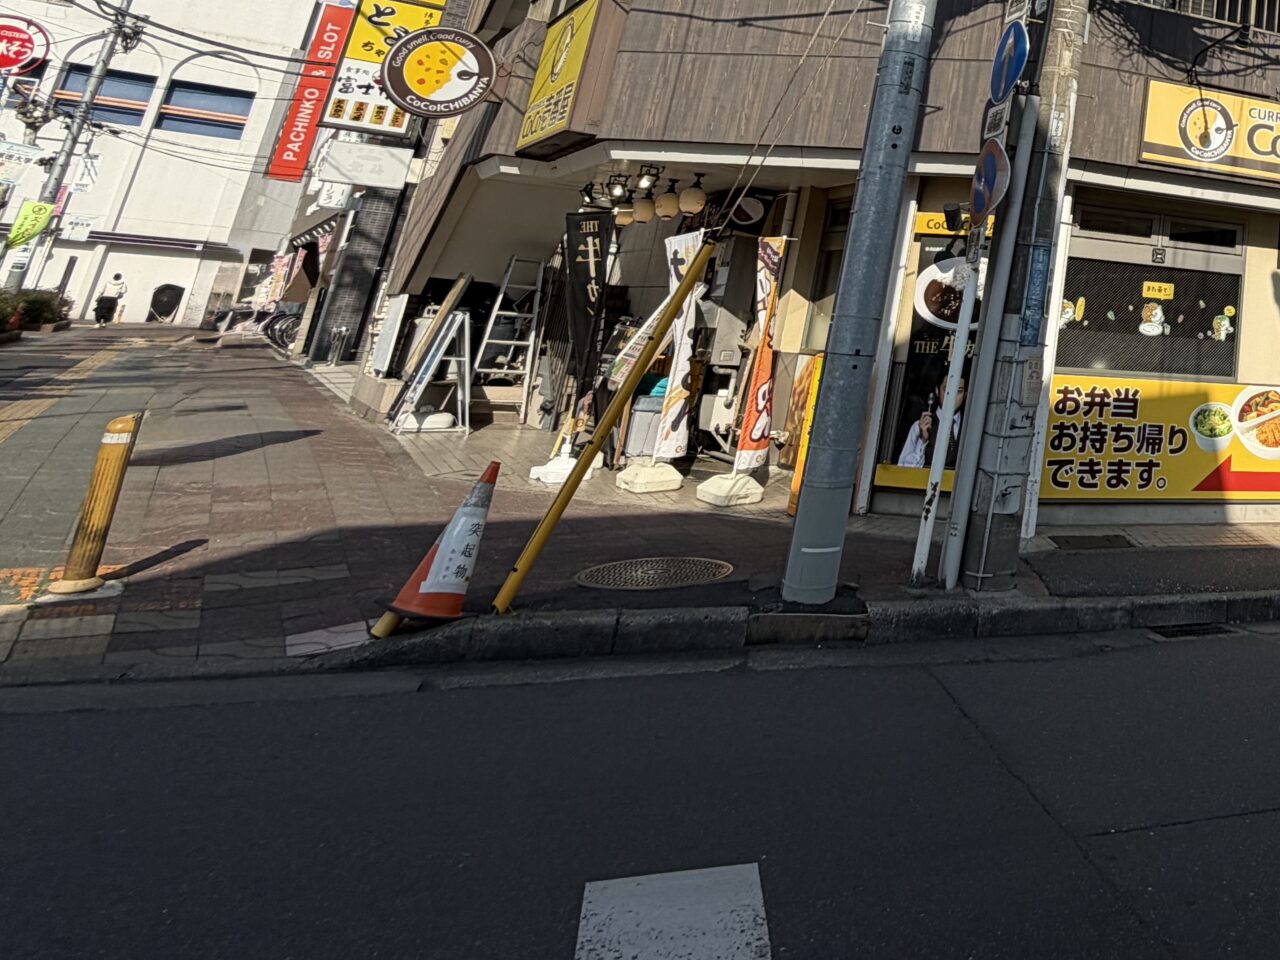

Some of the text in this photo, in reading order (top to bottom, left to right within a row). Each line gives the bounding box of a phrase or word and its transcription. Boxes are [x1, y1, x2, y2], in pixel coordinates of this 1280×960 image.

[318, 22, 342, 60] SLOT
[282, 87, 320, 162] PACHINKO
[914, 340, 939, 354] THE
[1053, 385, 1142, 421] お弁当
[1049, 422, 1190, 456] お持ち帰り
[1045, 457, 1169, 491] できます。
